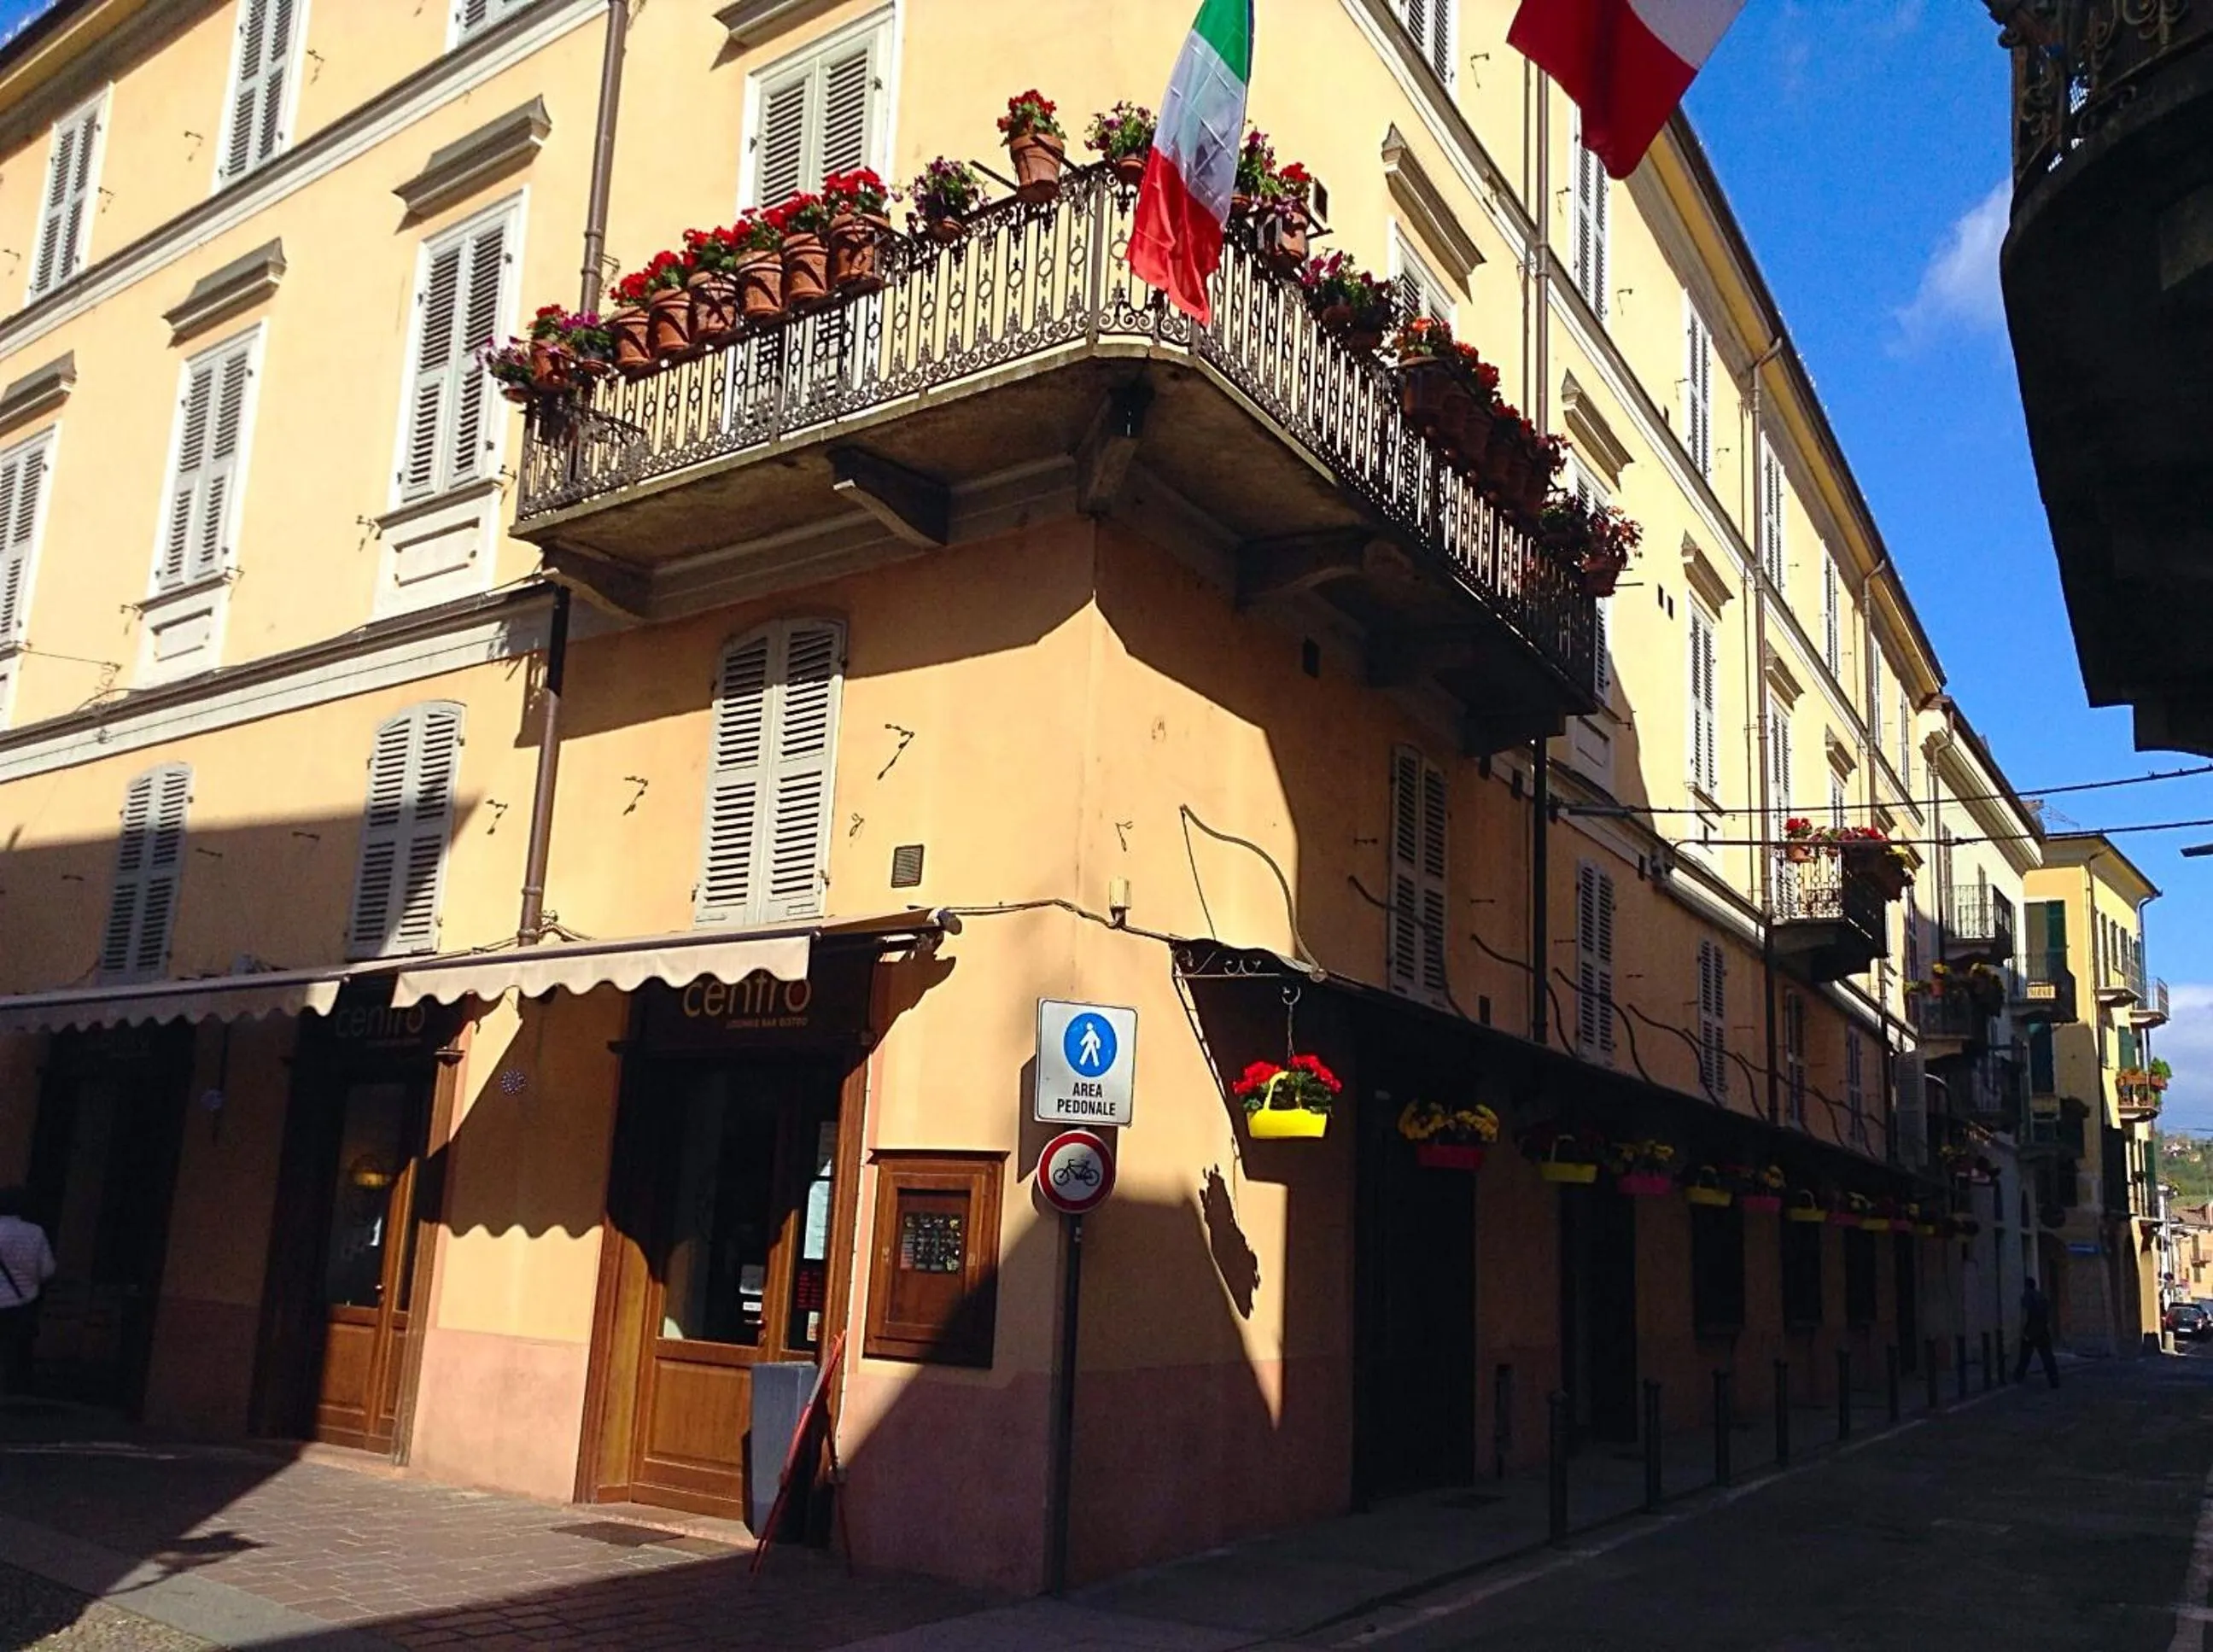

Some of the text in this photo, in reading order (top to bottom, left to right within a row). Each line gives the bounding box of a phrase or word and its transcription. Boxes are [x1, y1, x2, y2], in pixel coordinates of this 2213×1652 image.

[682, 972, 813, 1018] centro
[1072, 1083, 1102, 1097] AREA
[1057, 1099, 1115, 1115] PEDONALE
